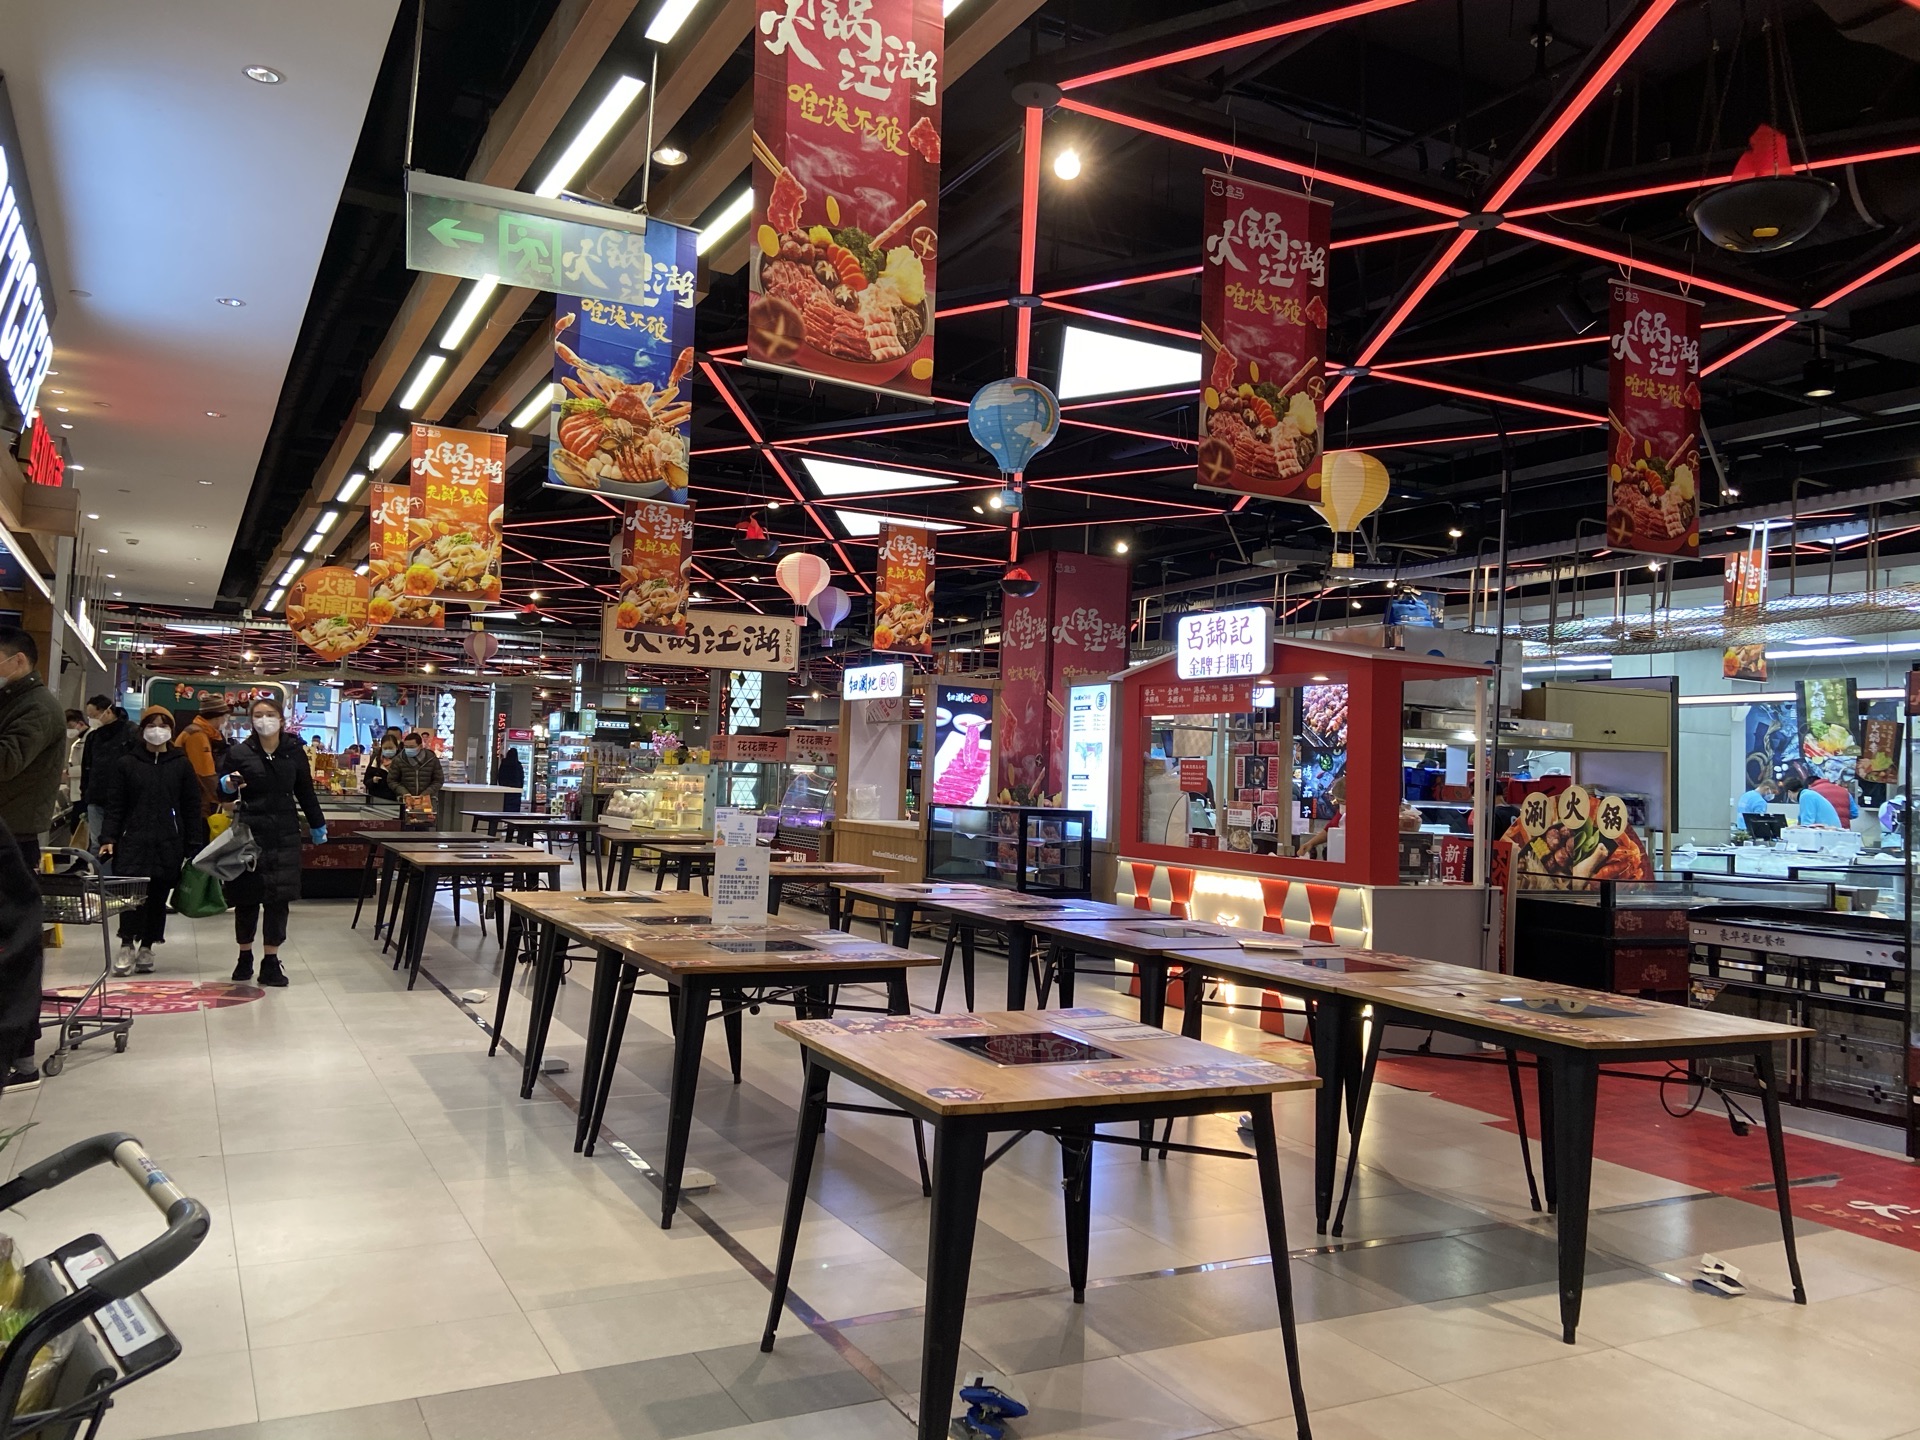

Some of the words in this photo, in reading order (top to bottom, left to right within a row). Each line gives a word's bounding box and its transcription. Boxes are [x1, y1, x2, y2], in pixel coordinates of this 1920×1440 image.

[788, 83, 910, 156] 唯快不破
[1206, 207, 1326, 288] 火锅江湖
[0, 145, 54, 433] UTCHER
[1225, 282, 1306, 326] 唯快不破
[581, 298, 673, 343] 唯快不破
[1611, 309, 1699, 376] 火锅江湖
[1625, 373, 1685, 409] 唯快不破
[412, 441, 503, 485] 火锅江湖
[1188, 652, 1253, 677] 金牌手撕鸡
[737, 740, 778, 752] 花花栗子
[797, 734, 833, 746] 花花栗子
[1524, 791, 1623, 832] 涮火锅
[1443, 843, 1461, 881] 新品
[1719, 928, 1787, 947] 豪华型配餐柜
